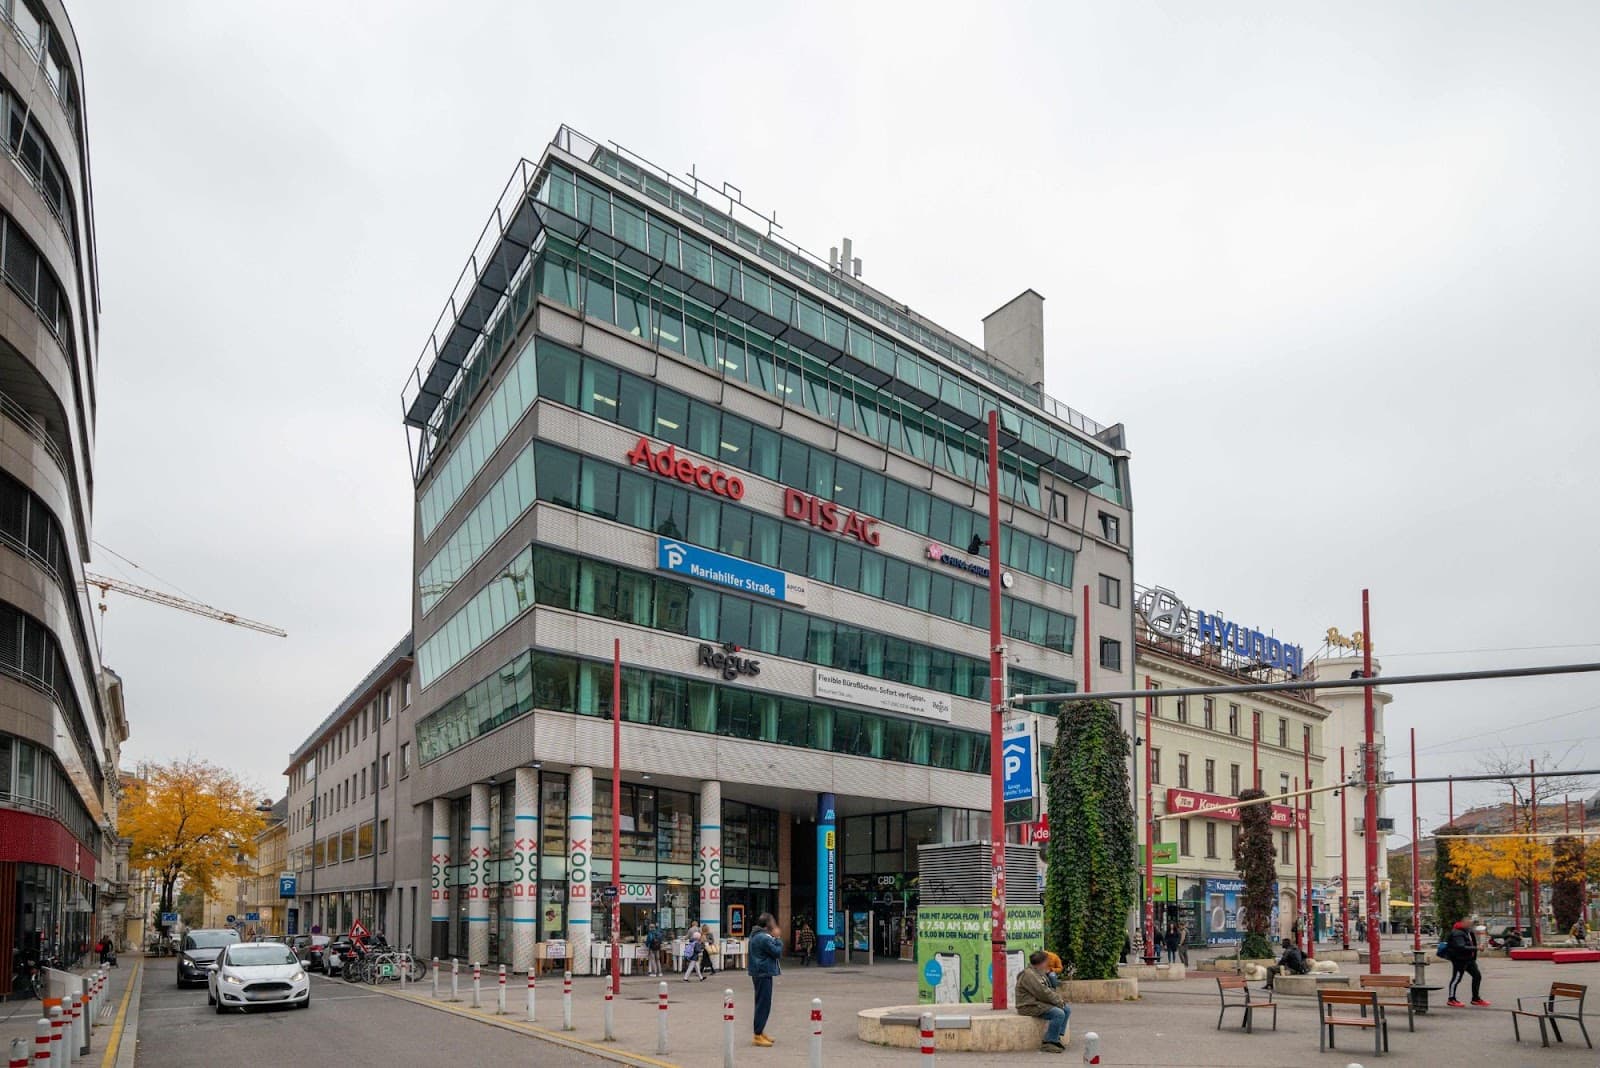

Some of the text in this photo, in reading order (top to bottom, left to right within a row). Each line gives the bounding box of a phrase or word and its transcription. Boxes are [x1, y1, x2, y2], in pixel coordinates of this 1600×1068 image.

[628, 437, 744, 499] Adecco
[784, 488, 880, 546] DIS AG
[690, 563, 776, 596] Mariahilfer Straße
[1198, 610, 1304, 675] HYUNDAI
[698, 643, 760, 680] Regus
[818, 674, 842, 684] Flexible
[572, 839, 586, 897] BOOX
[878, 876, 895, 885] CBD
[620, 884, 652, 897] BOOX
[942, 912, 961, 920] APCOA
[962, 912, 979, 920] FLOW
[947, 922, 960, 930] AM
[962, 922, 980, 931] TAG
[1013, 920, 1025, 930] AM
[958, 931, 979, 939] NACHT
[1023, 931, 1042, 939] NACHT
